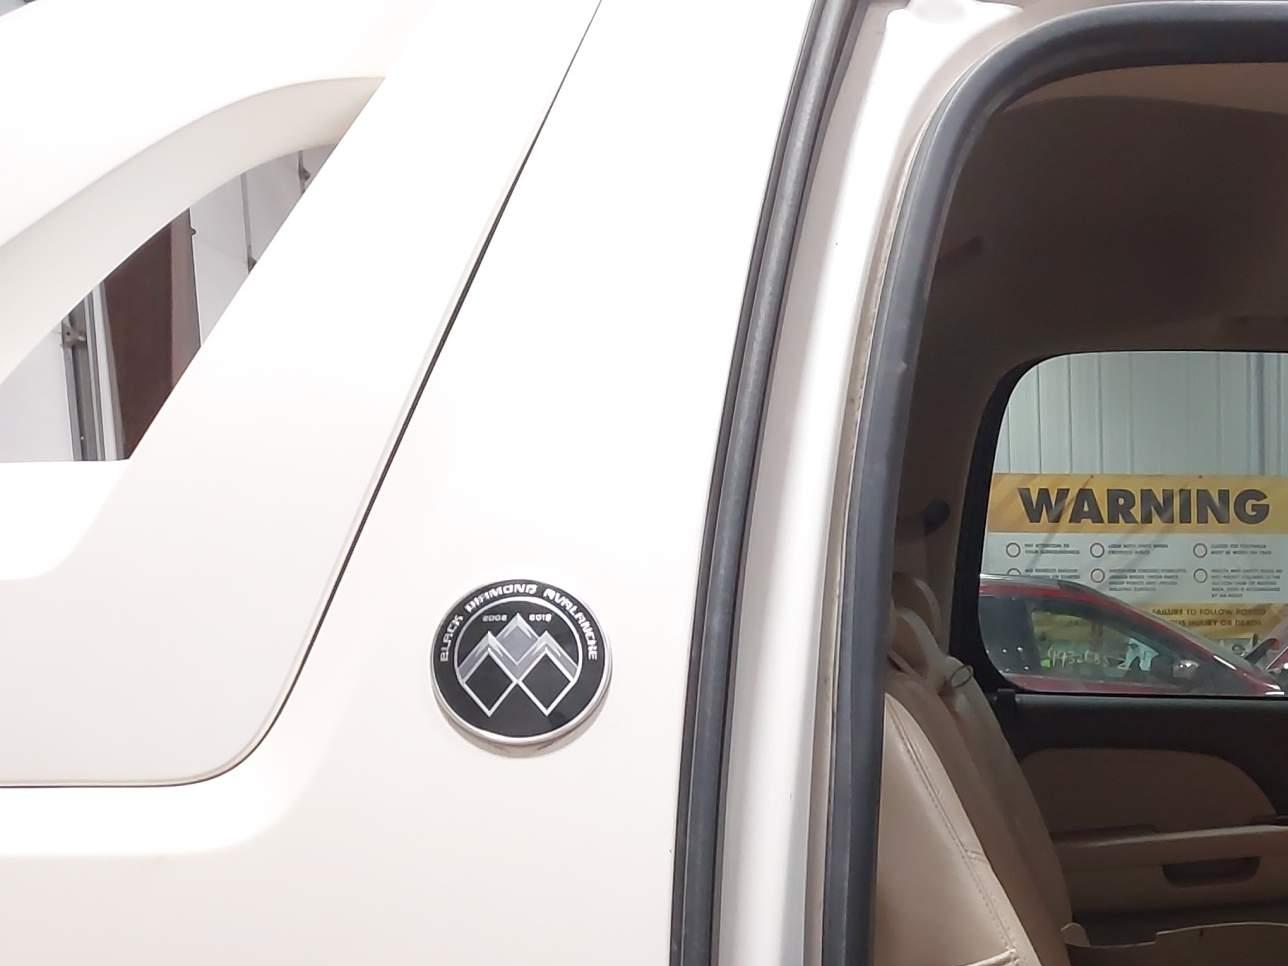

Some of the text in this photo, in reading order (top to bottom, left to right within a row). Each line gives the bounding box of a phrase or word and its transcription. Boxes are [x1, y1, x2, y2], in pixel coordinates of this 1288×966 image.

[1018, 487, 1270, 525] WARNING
[440, 583, 599, 662] BLACK DIAMOND AVALANCHE
[1186, 607, 1197, 616] TO
[1199, 607, 1233, 616] FOLLOW
